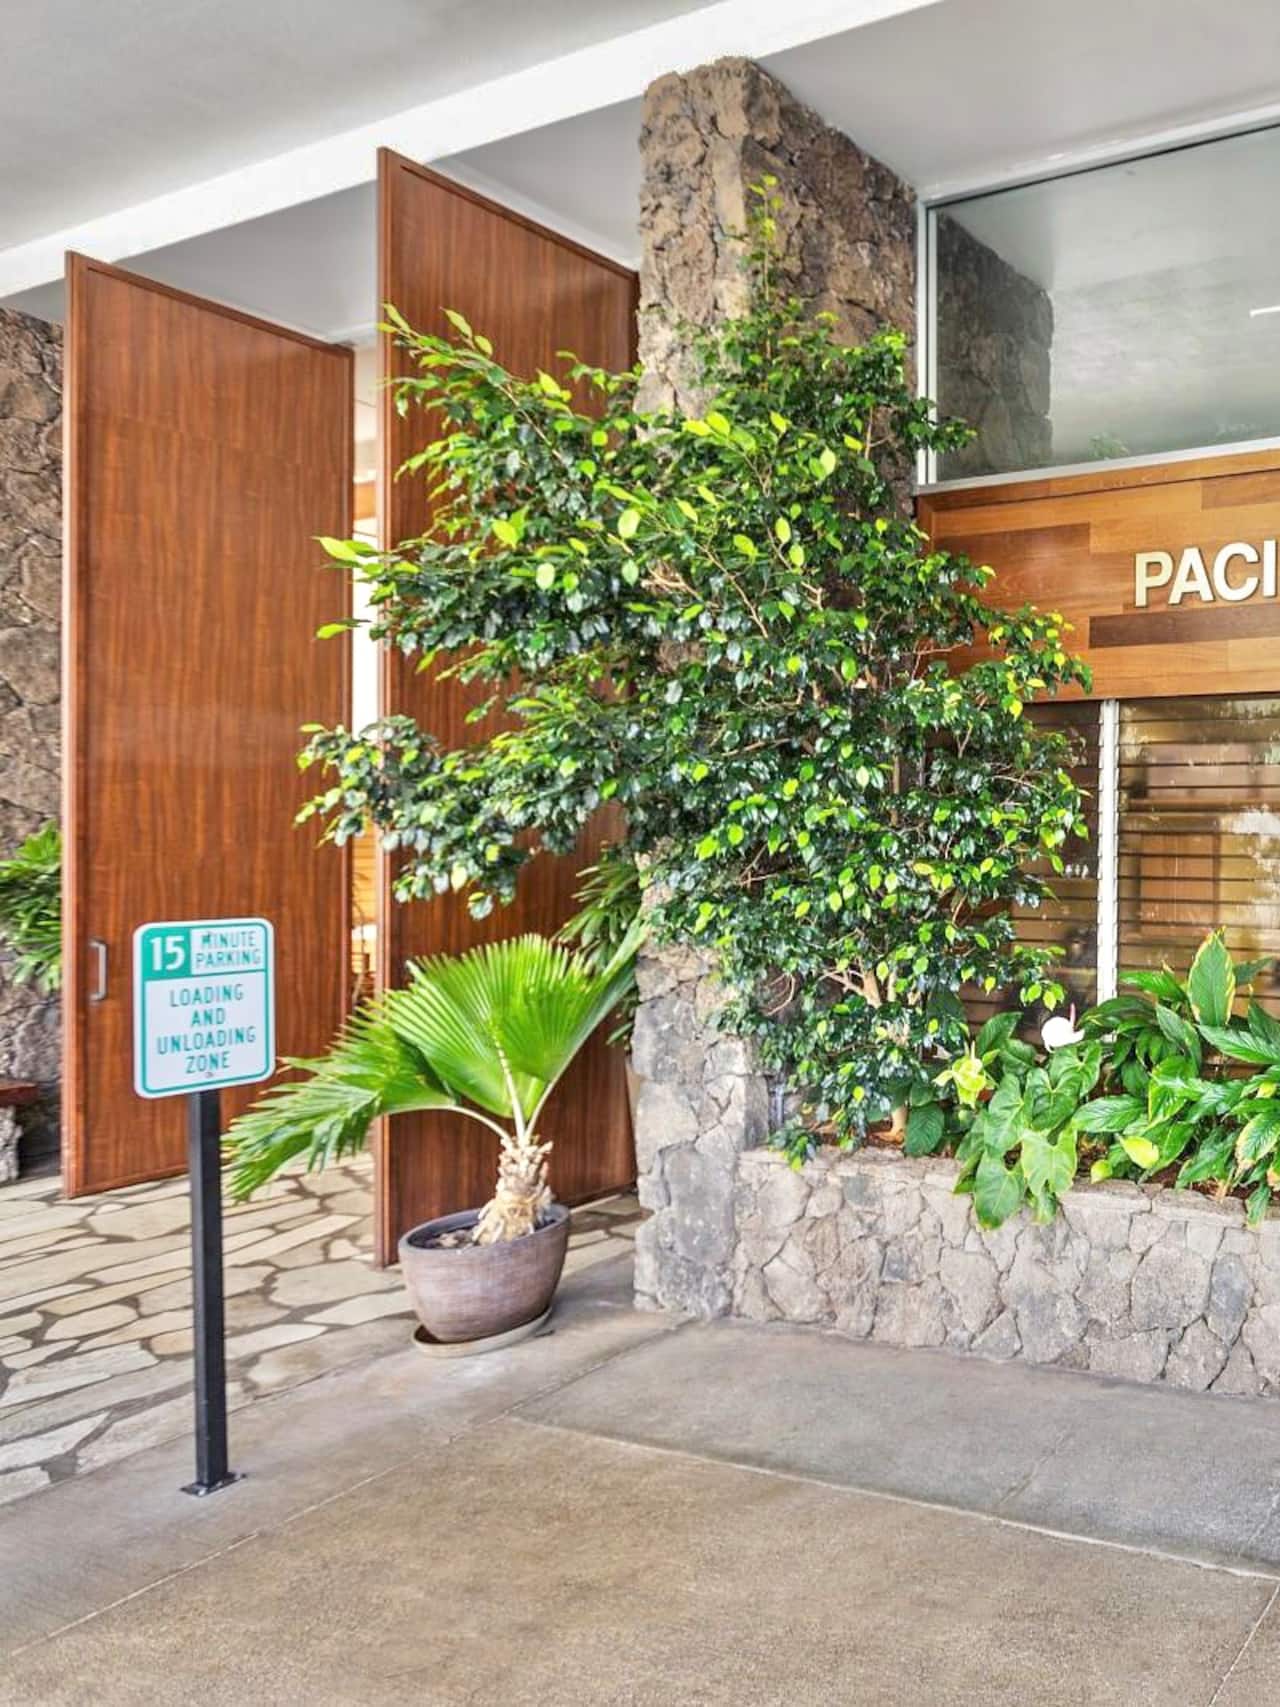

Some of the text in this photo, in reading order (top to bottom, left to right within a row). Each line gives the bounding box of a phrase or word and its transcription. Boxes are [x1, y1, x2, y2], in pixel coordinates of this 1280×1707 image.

[201, 931, 257, 948] MINUTE
[151, 935, 185, 972] 15
[196, 949, 261, 968] PARKING
[170, 984, 244, 1007] LOADING
[191, 1008, 226, 1027] AND
[156, 1026, 256, 1055] UNLOADING
[185, 1051, 231, 1074] ZONE
